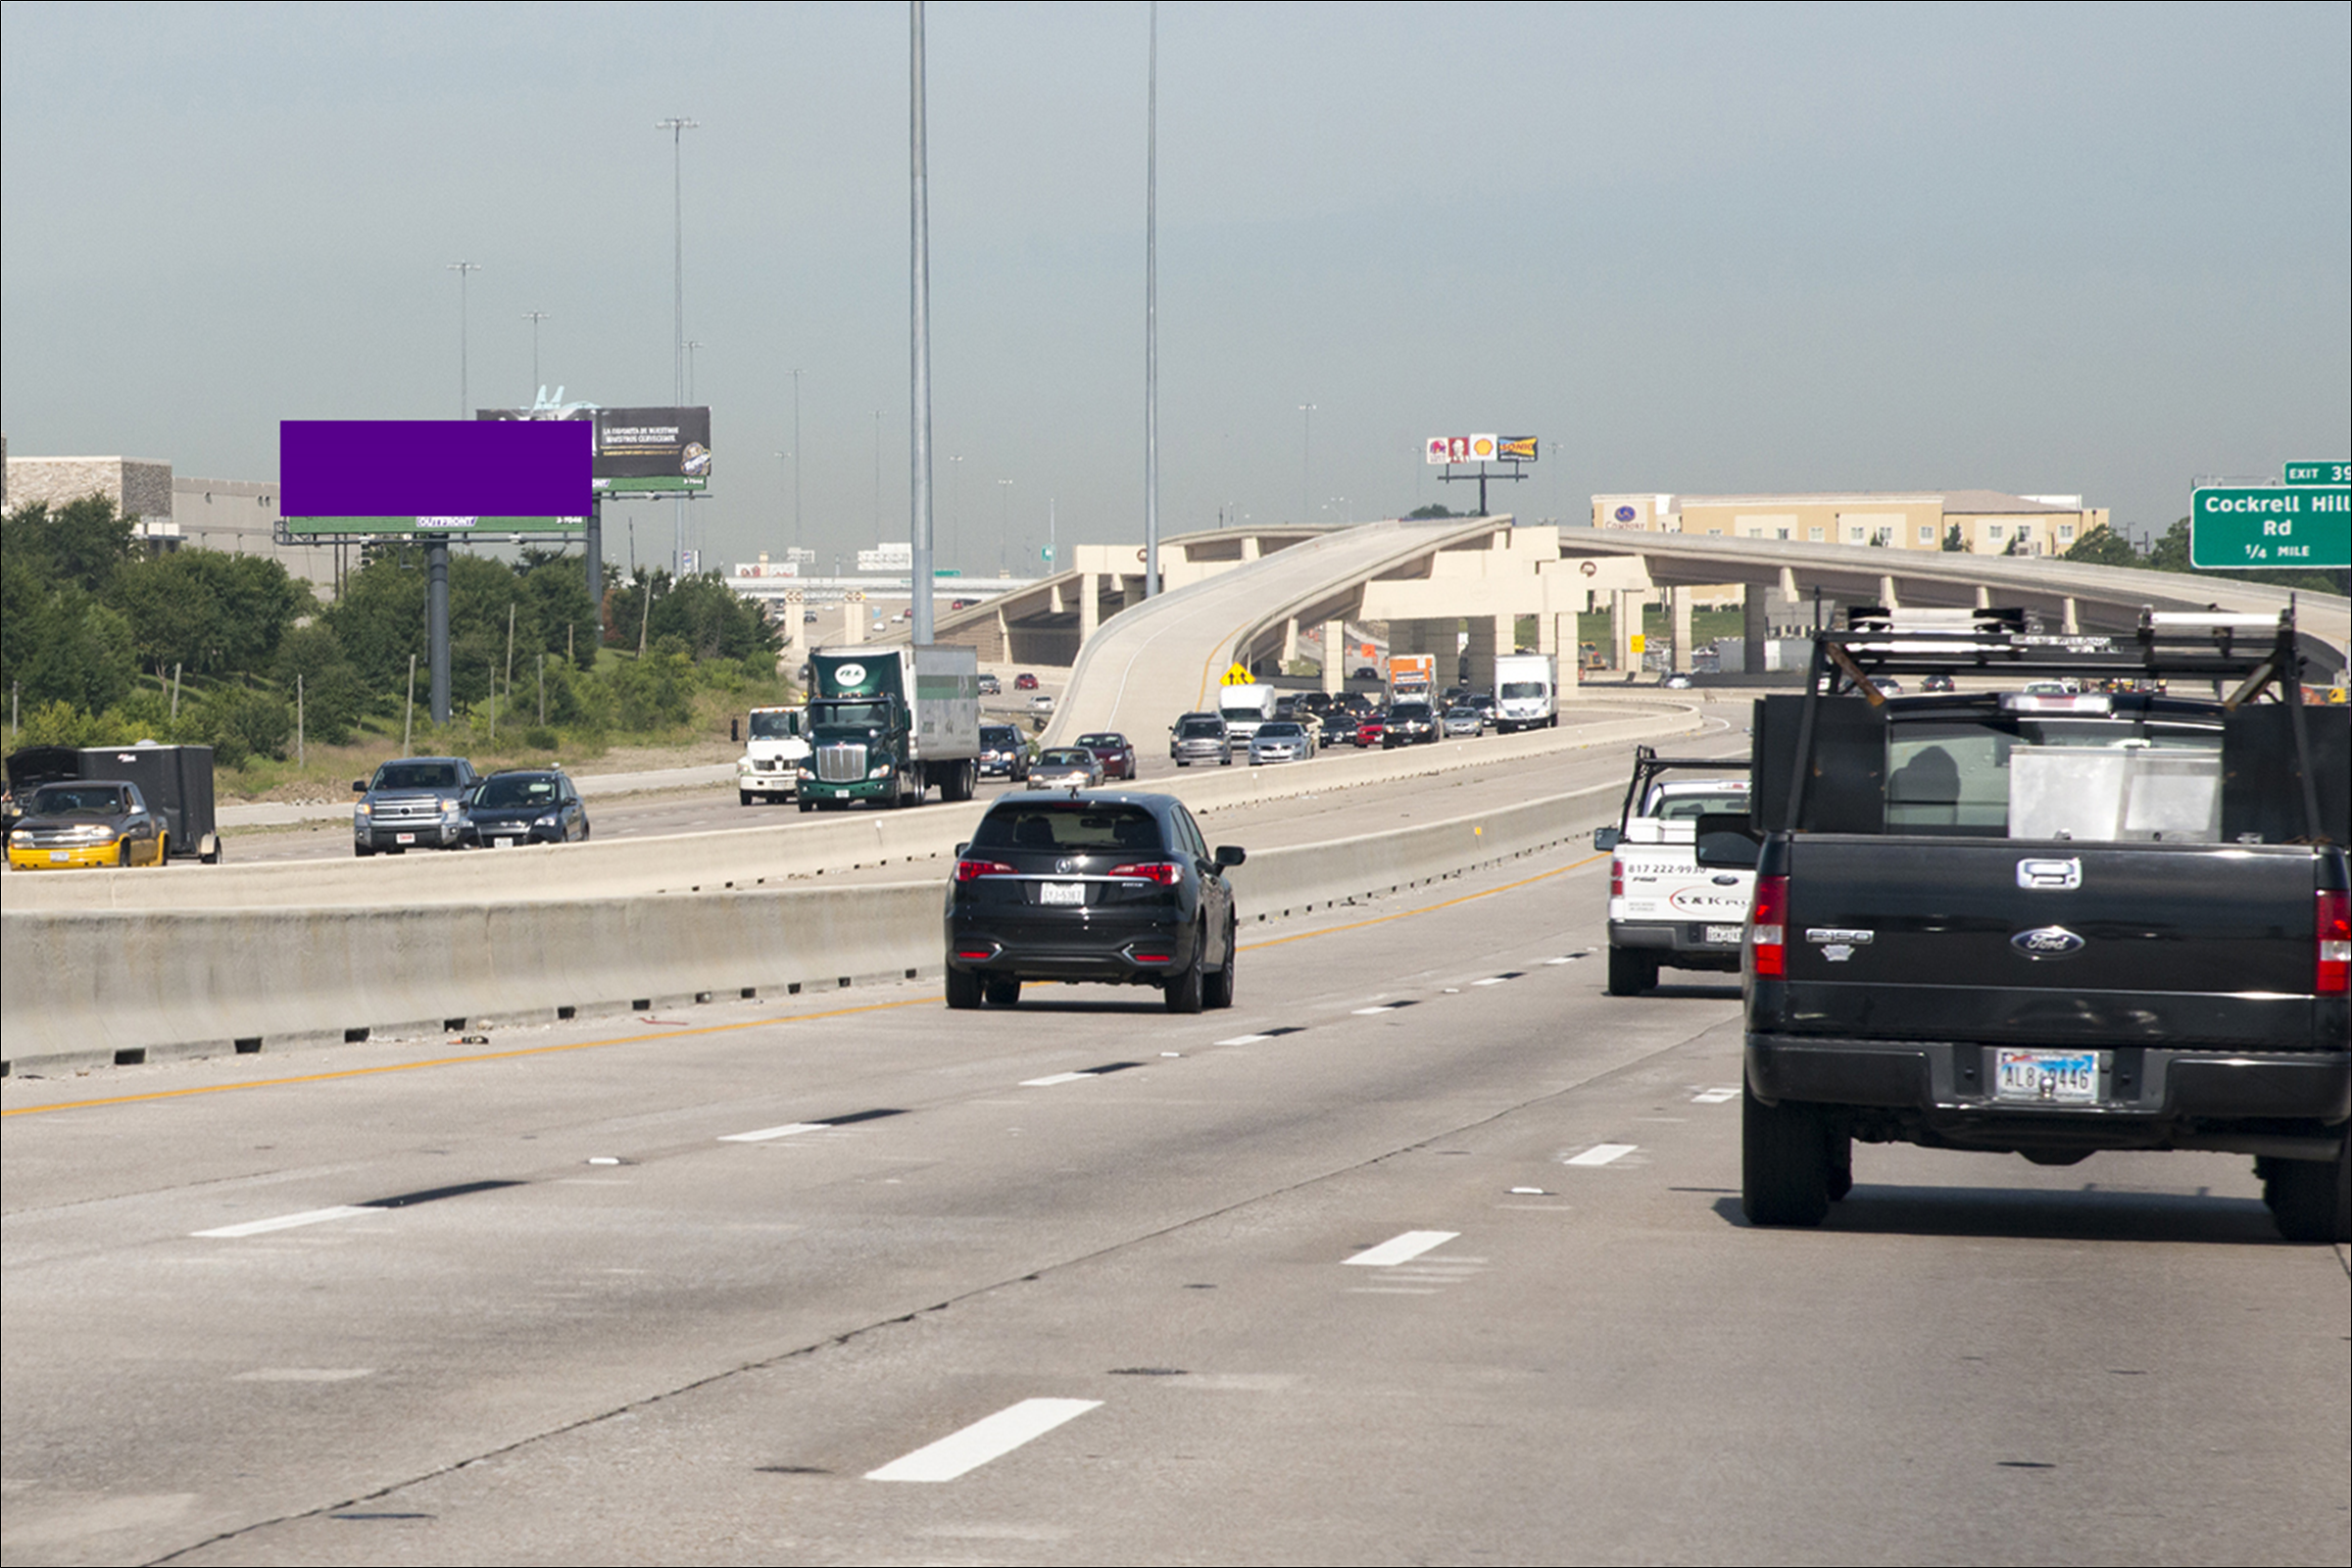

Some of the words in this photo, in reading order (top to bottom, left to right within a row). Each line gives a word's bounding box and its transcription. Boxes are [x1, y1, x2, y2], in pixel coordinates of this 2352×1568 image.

[1499, 442, 1534, 452] SONIC
[2288, 467, 2320, 479] EXIT
[2205, 495, 2300, 513] Cockrell
[2311, 494, 2351, 513] Hill
[416, 517, 473, 526] OUTFRONT
[2263, 518, 2291, 535] Rd
[2244, 544, 2268, 560] 1/4
[2277, 545, 2310, 557] MILE
[1628, 864, 1649, 873] 817
[1677, 896, 1687, 905] S
[1708, 896, 1721, 905] K
[2026, 932, 2070, 951] Ford
